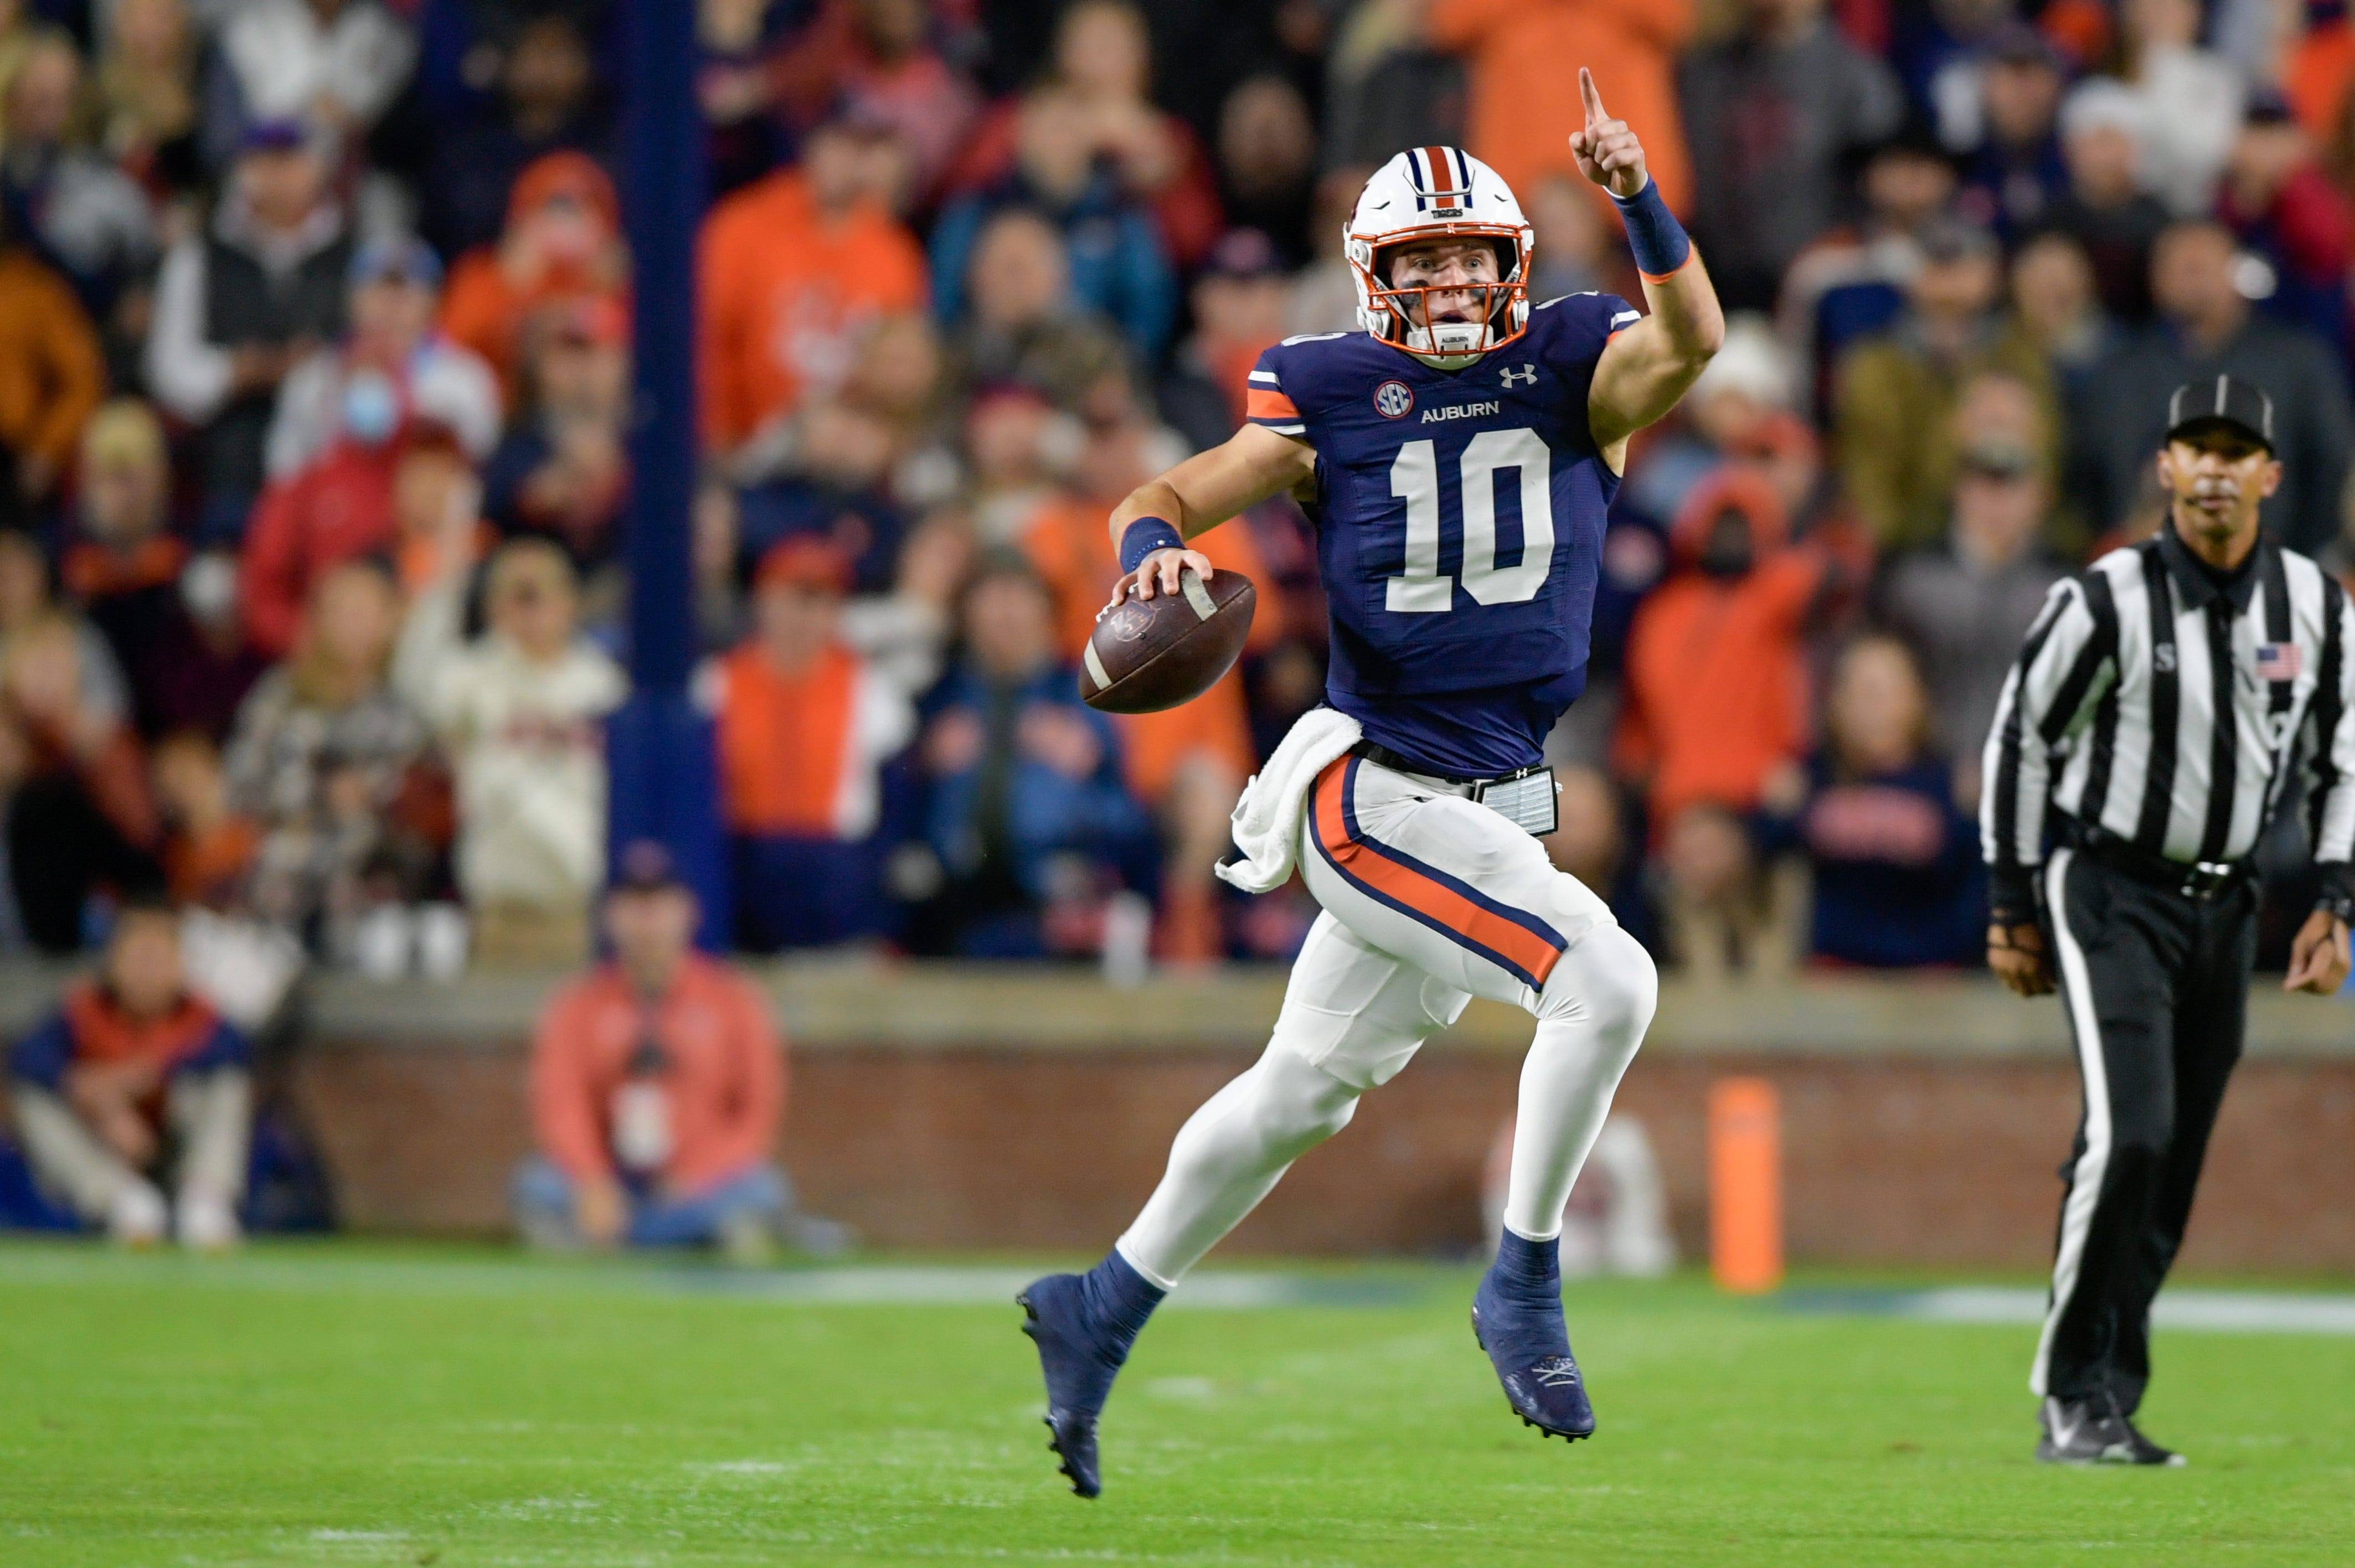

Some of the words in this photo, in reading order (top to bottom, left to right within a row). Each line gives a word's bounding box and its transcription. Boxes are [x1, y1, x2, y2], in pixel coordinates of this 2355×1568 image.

[1377, 383, 1410, 416] SEC
[1421, 400, 1499, 424] AUBURN
[1385, 427, 1555, 612] 10
[2155, 642, 2176, 671] S
